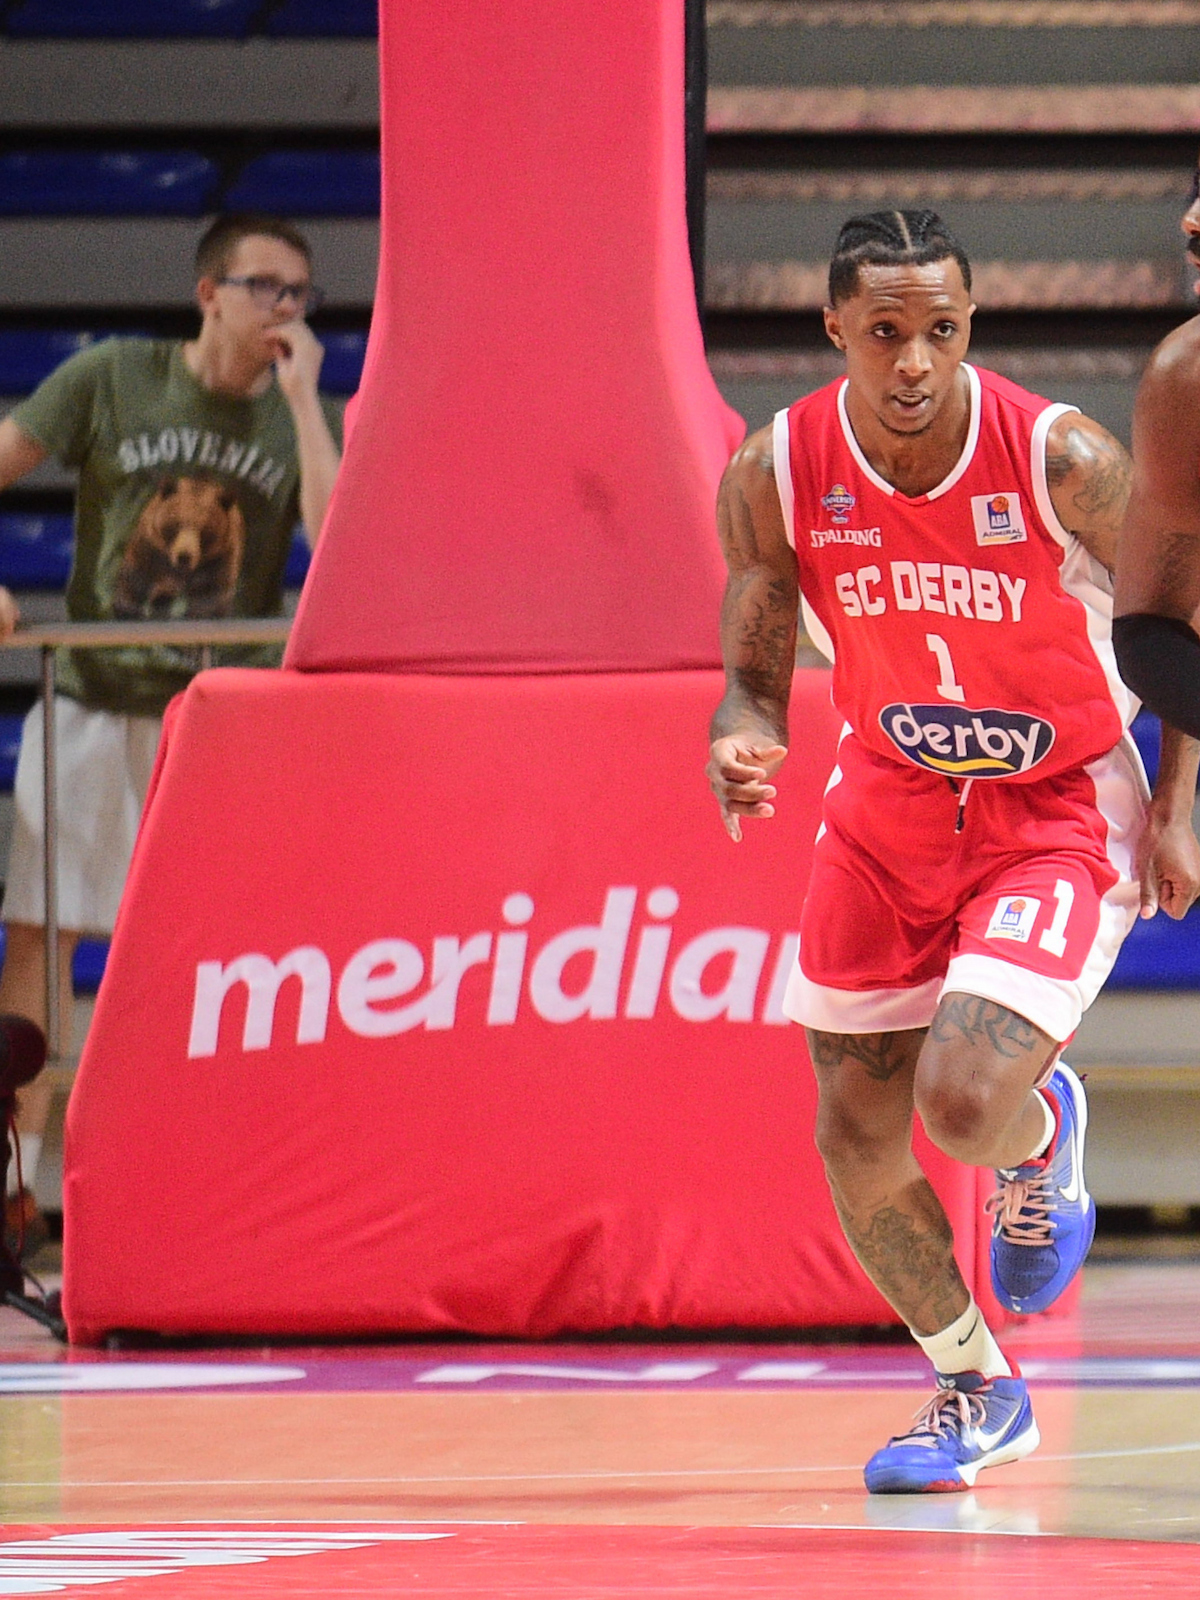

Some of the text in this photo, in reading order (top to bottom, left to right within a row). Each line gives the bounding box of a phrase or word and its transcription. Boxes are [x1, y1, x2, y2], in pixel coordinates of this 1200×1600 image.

[810, 527, 882, 548] SPALDING
[835, 560, 1027, 622] SC DERBY
[926, 634, 965, 702] 1
[889, 703, 1042, 772] derby
[1038, 878, 1075, 959] 1
